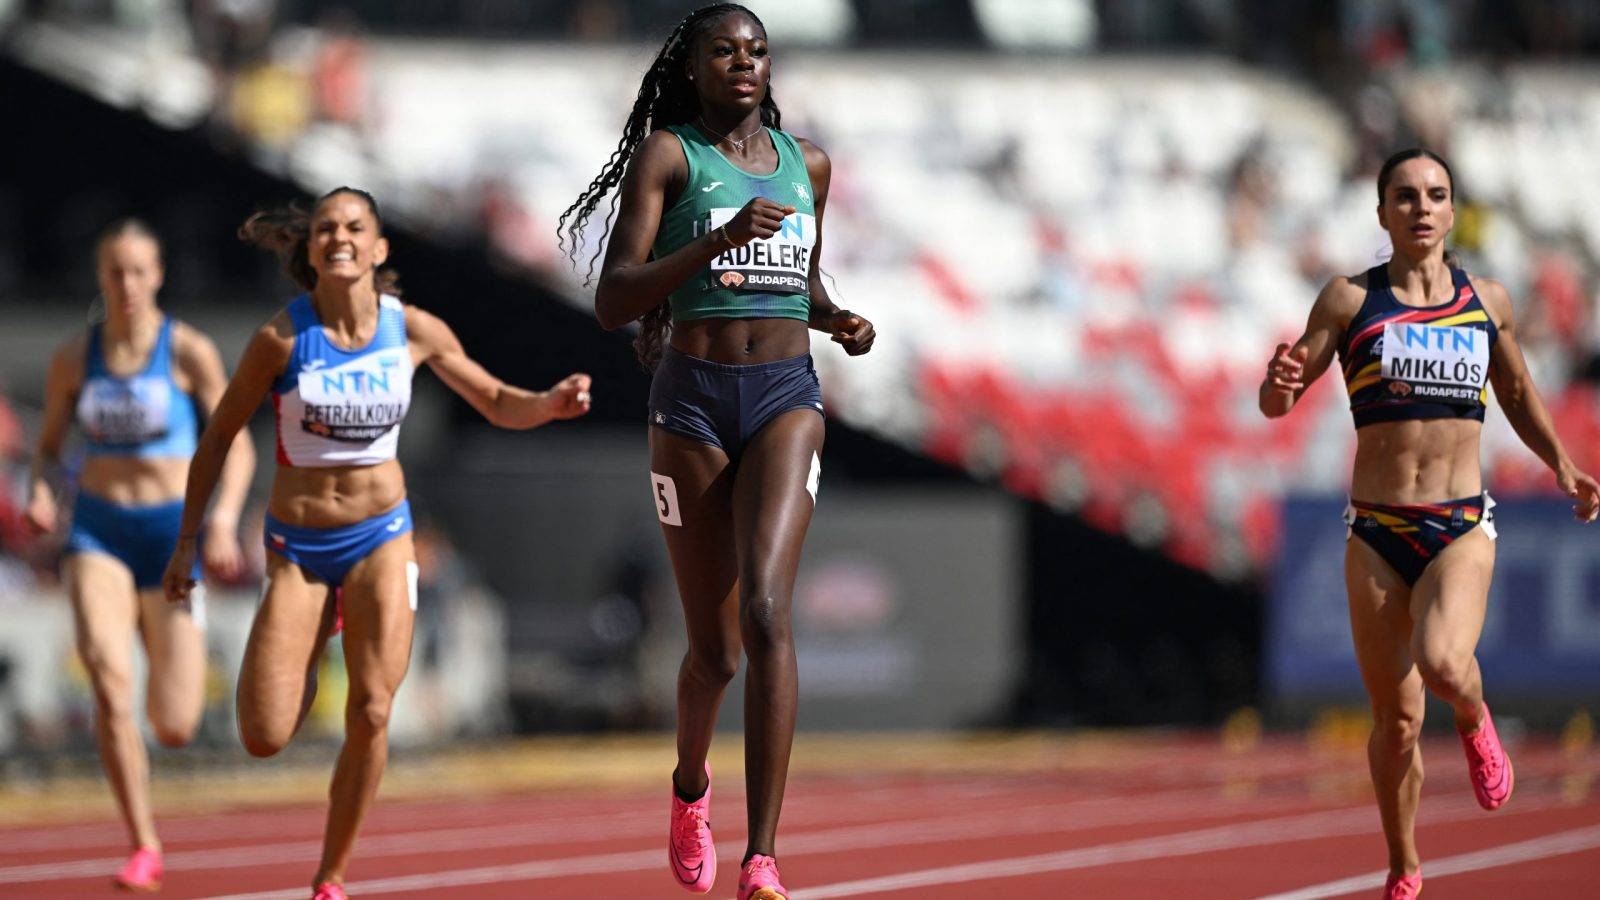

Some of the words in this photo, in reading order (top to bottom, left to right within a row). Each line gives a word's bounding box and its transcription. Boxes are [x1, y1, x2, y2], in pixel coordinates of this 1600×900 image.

[718, 242, 807, 272] ADELEKE
[1406, 325, 1474, 353] NTN
[322, 371, 390, 393] NTN
[1391, 357, 1481, 384] MIKLÓS
[656, 482, 670, 517] 5
